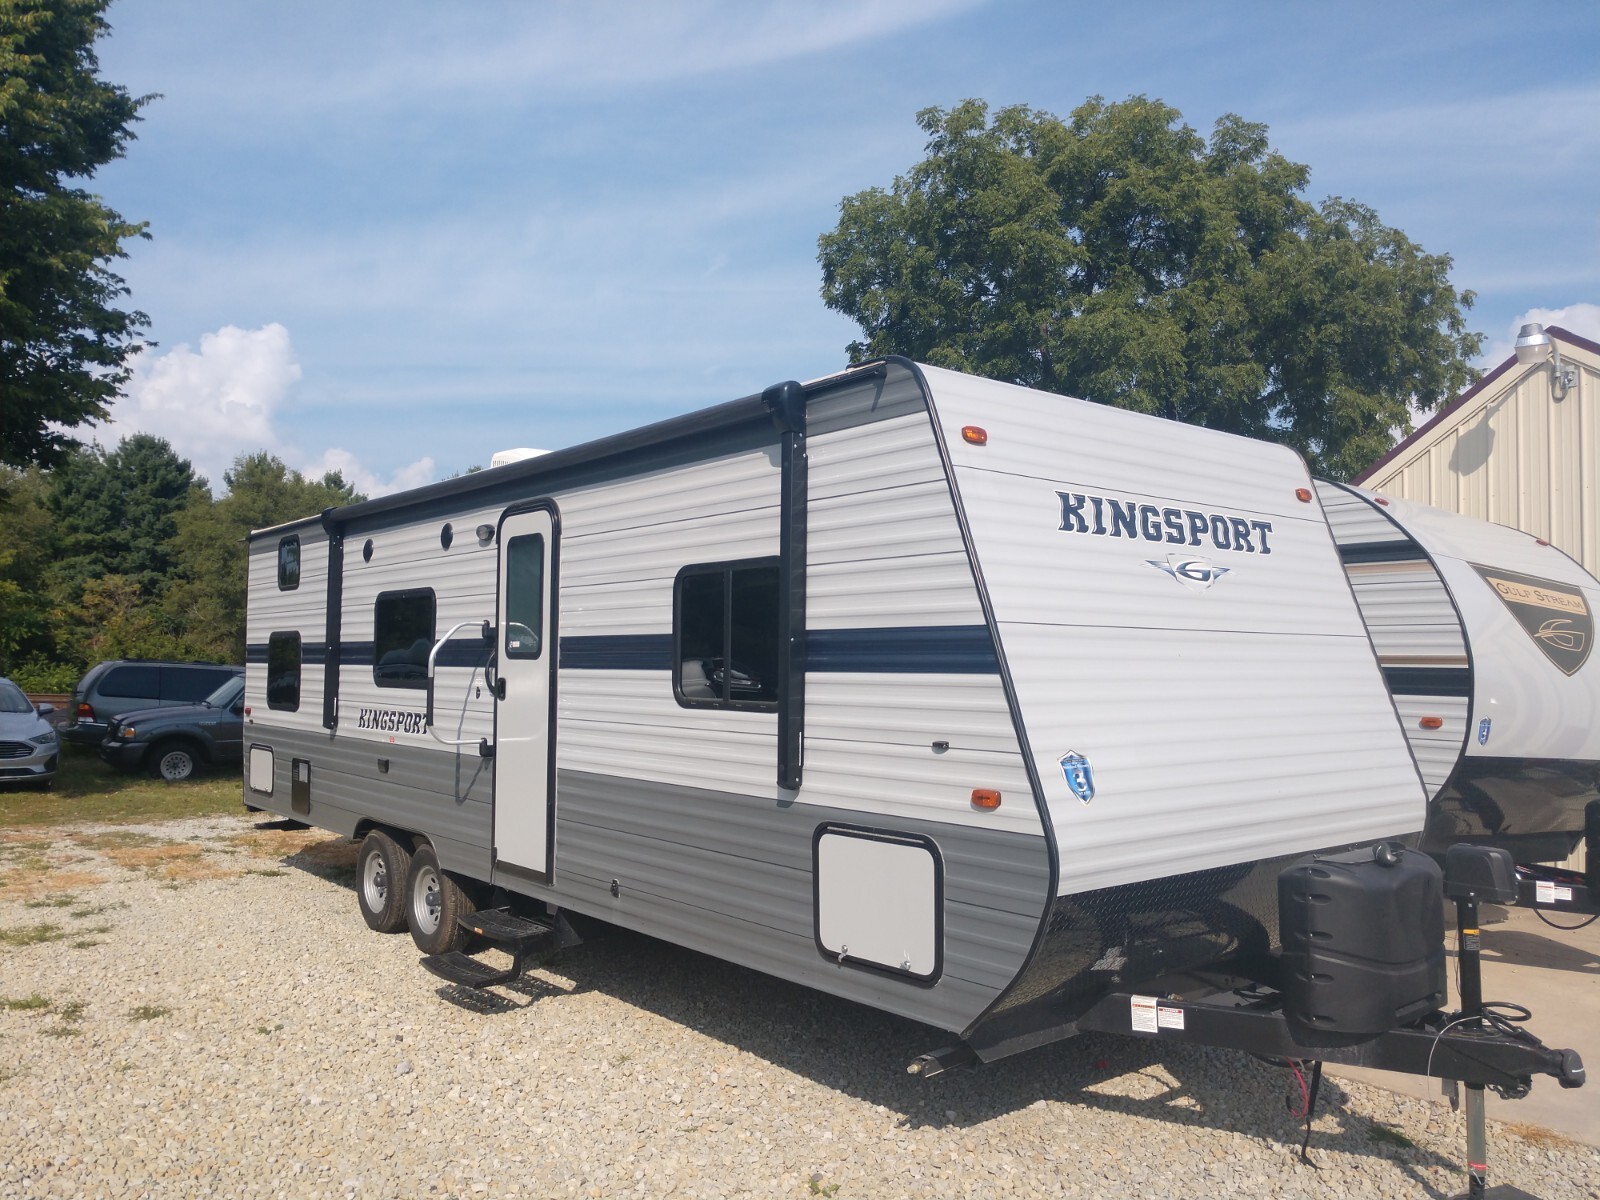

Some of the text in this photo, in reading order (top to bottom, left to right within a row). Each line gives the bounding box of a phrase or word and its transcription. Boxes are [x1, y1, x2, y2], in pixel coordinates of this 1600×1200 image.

[1055, 490, 1274, 555] KINGSPORT
[1496, 582, 1584, 610] GULF STREAM
